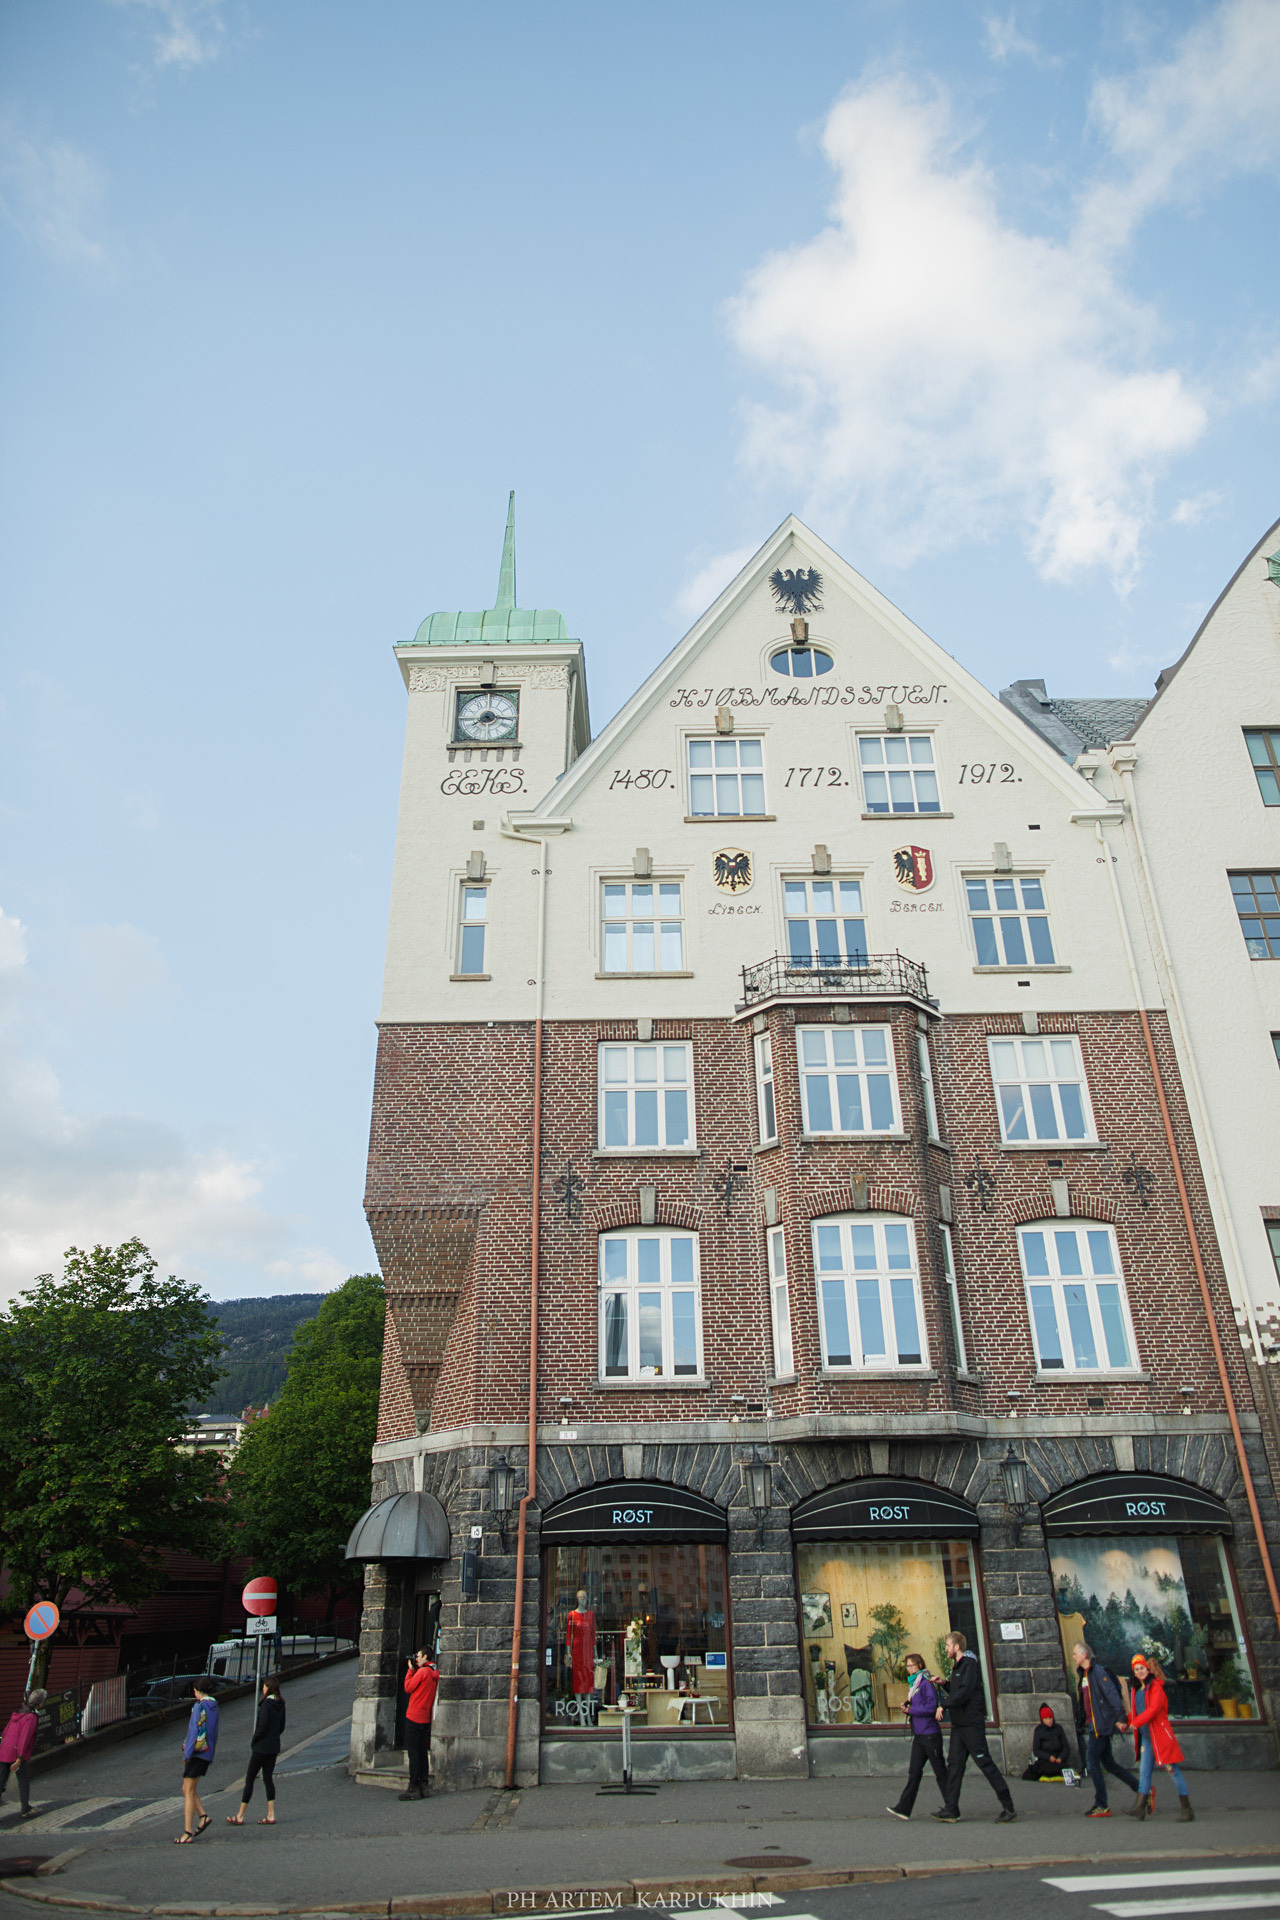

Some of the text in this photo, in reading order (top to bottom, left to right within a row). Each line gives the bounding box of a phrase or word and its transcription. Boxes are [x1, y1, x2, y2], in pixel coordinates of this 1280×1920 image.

[609, 769, 675, 790] 1480.
[785, 767, 849, 788] 1712.
[959, 763, 1023, 785] 1912.
[612, 1509, 654, 1524] RØST
[869, 1505, 910, 1521] RØST
[1125, 1501, 1166, 1516] RØST
[555, 1699, 598, 1717] RØST
[817, 1695, 861, 1712] RØST
